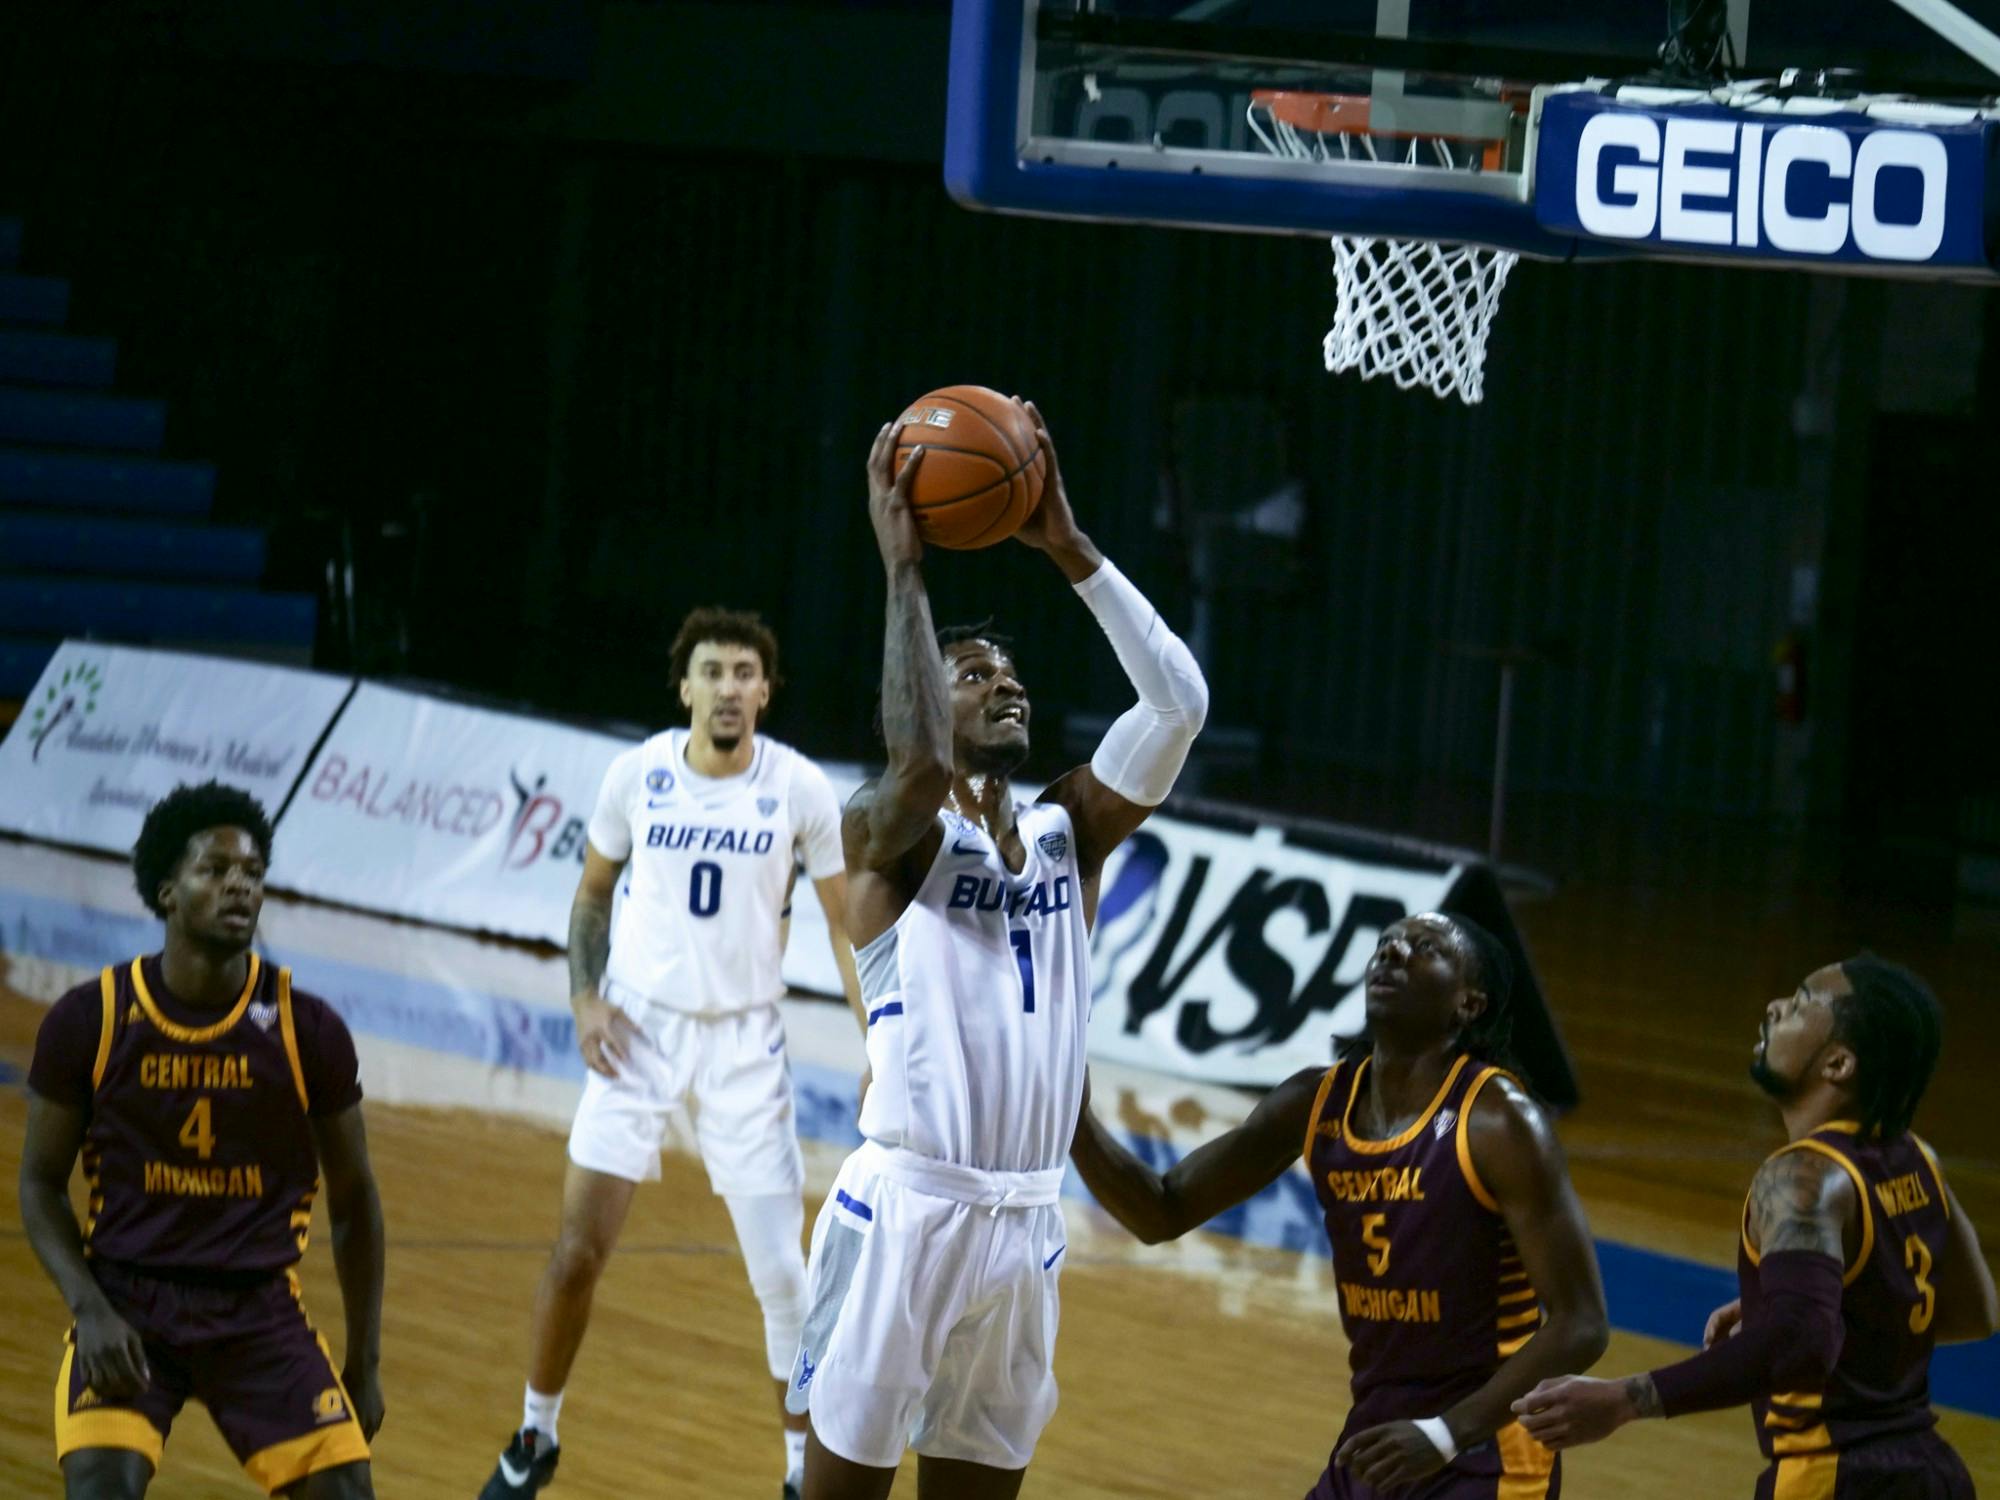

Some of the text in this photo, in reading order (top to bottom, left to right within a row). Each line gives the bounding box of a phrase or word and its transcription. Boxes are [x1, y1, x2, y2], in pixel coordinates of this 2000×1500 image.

[1576, 113, 1948, 261] GEICO
[311, 754, 503, 838] BALANCED
[646, 824, 774, 854] BUFFALO
[689, 861, 722, 918] 0
[1009, 929, 1035, 1013] 1
[140, 1054, 254, 1089] CENTRAL
[178, 1097, 216, 1159] 4
[1327, 1166, 1425, 1201] CENTRAL
[1361, 1212, 1391, 1277] 5
[1905, 1233, 1935, 1335] 3
